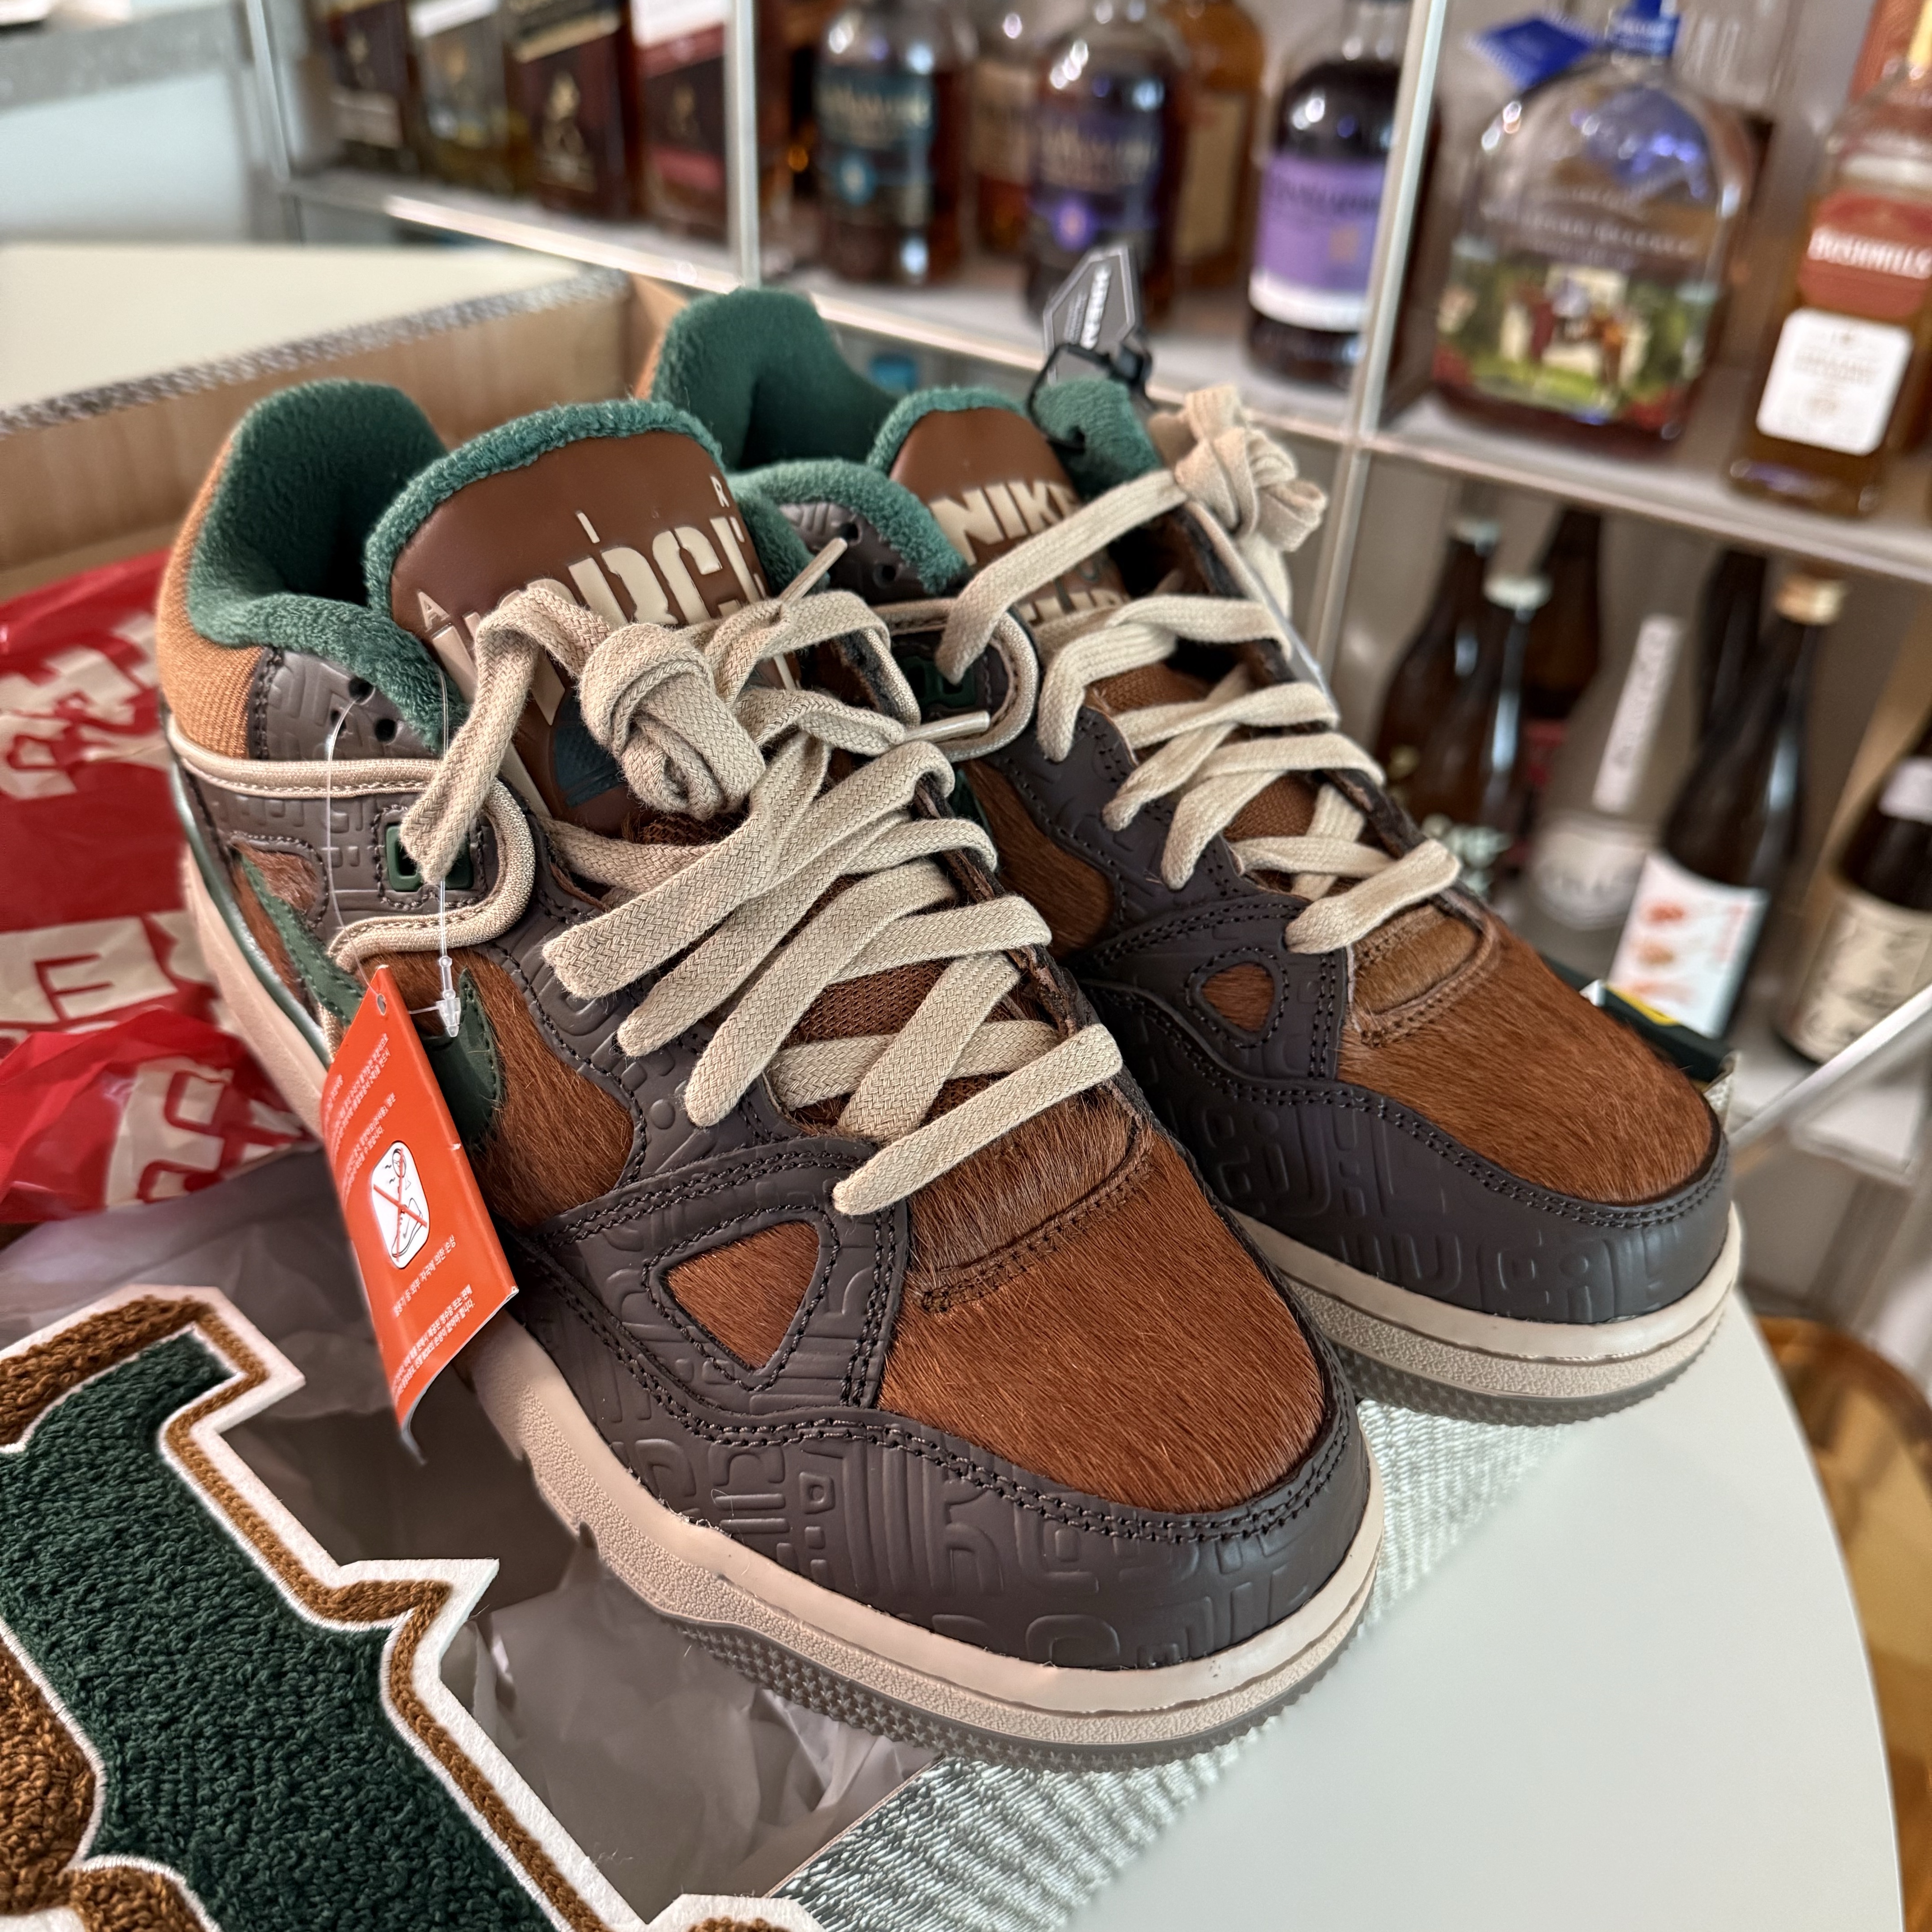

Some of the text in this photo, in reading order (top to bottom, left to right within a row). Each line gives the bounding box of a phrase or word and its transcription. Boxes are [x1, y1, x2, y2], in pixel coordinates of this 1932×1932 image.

[419, 1260, 436, 1281] 자극에
[434, 1248, 446, 1266] 의한
[445, 1234, 456, 1253] 손상
